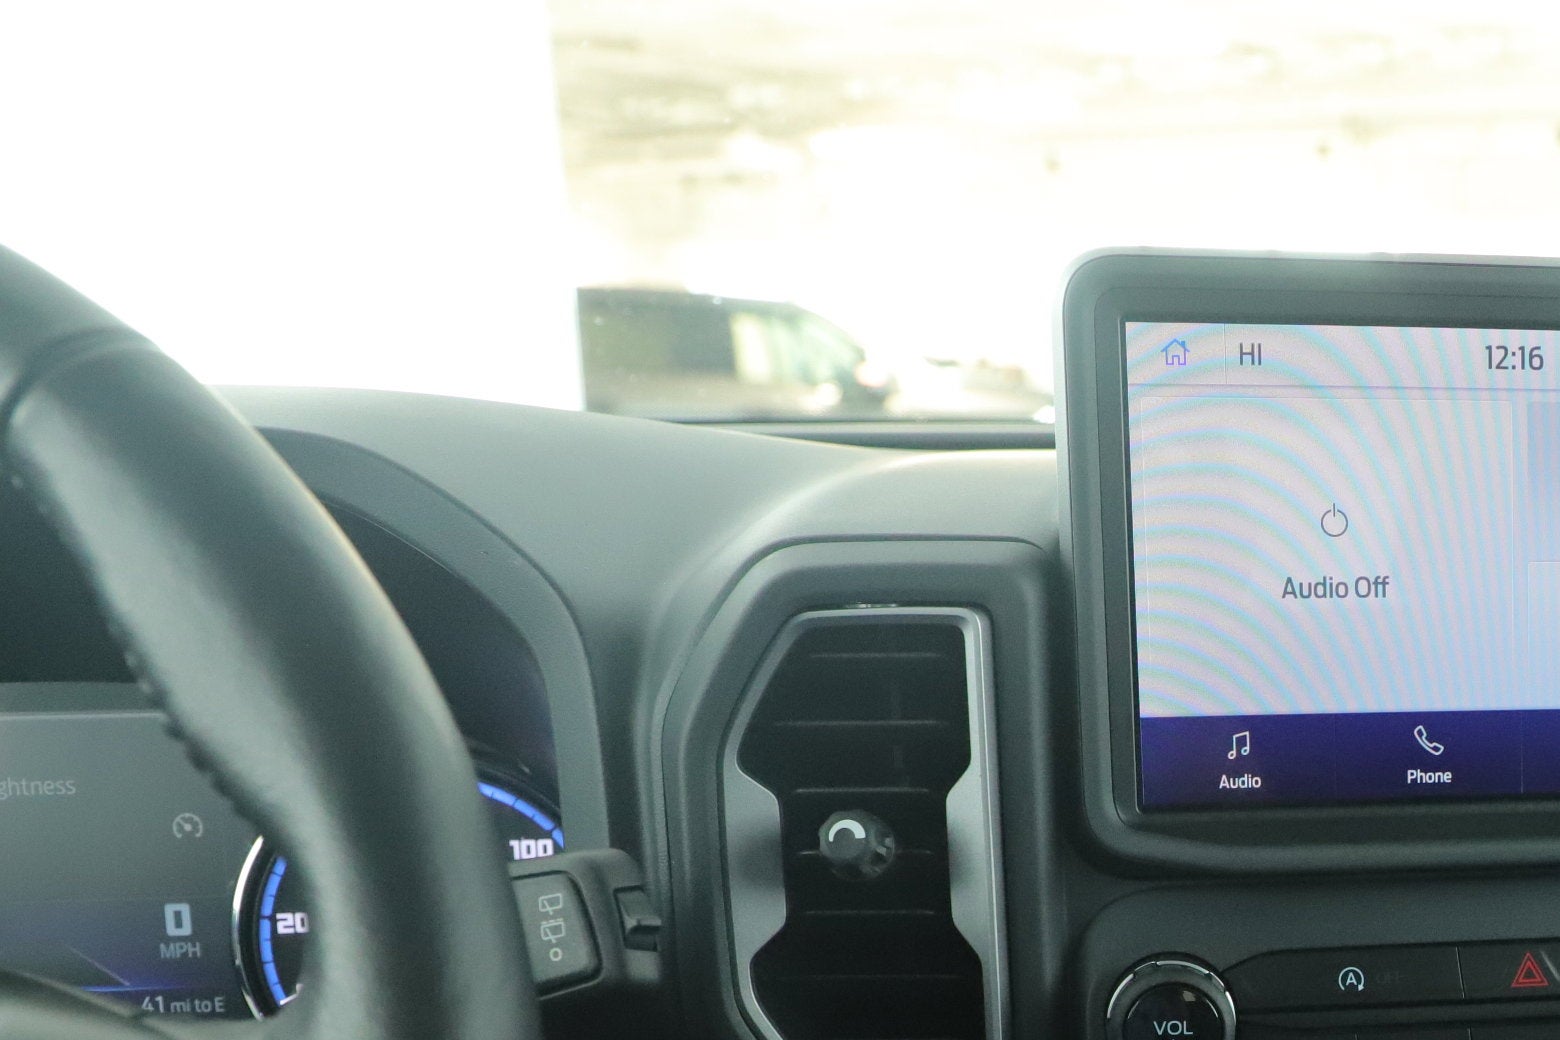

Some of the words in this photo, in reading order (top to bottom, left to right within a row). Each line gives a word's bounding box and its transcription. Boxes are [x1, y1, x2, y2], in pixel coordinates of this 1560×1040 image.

[1239, 342, 1263, 366] HI
[1484, 344, 1545, 371] 12:16
[1281, 576, 1350, 600] Audio
[1354, 575, 1390, 600] Off
[1218, 773, 1262, 790] Audio
[1406, 768, 1453, 785] Phone
[509, 838, 555, 861] 100
[164, 902, 193, 937] 0
[275, 911, 310, 935] 20
[159, 941, 201, 960] MPH
[141, 995, 165, 1014] 41
[170, 998, 192, 1013] mi
[194, 997, 213, 1013] to
[214, 996, 226, 1013] E
[1152, 1020, 1194, 1036] VOL
